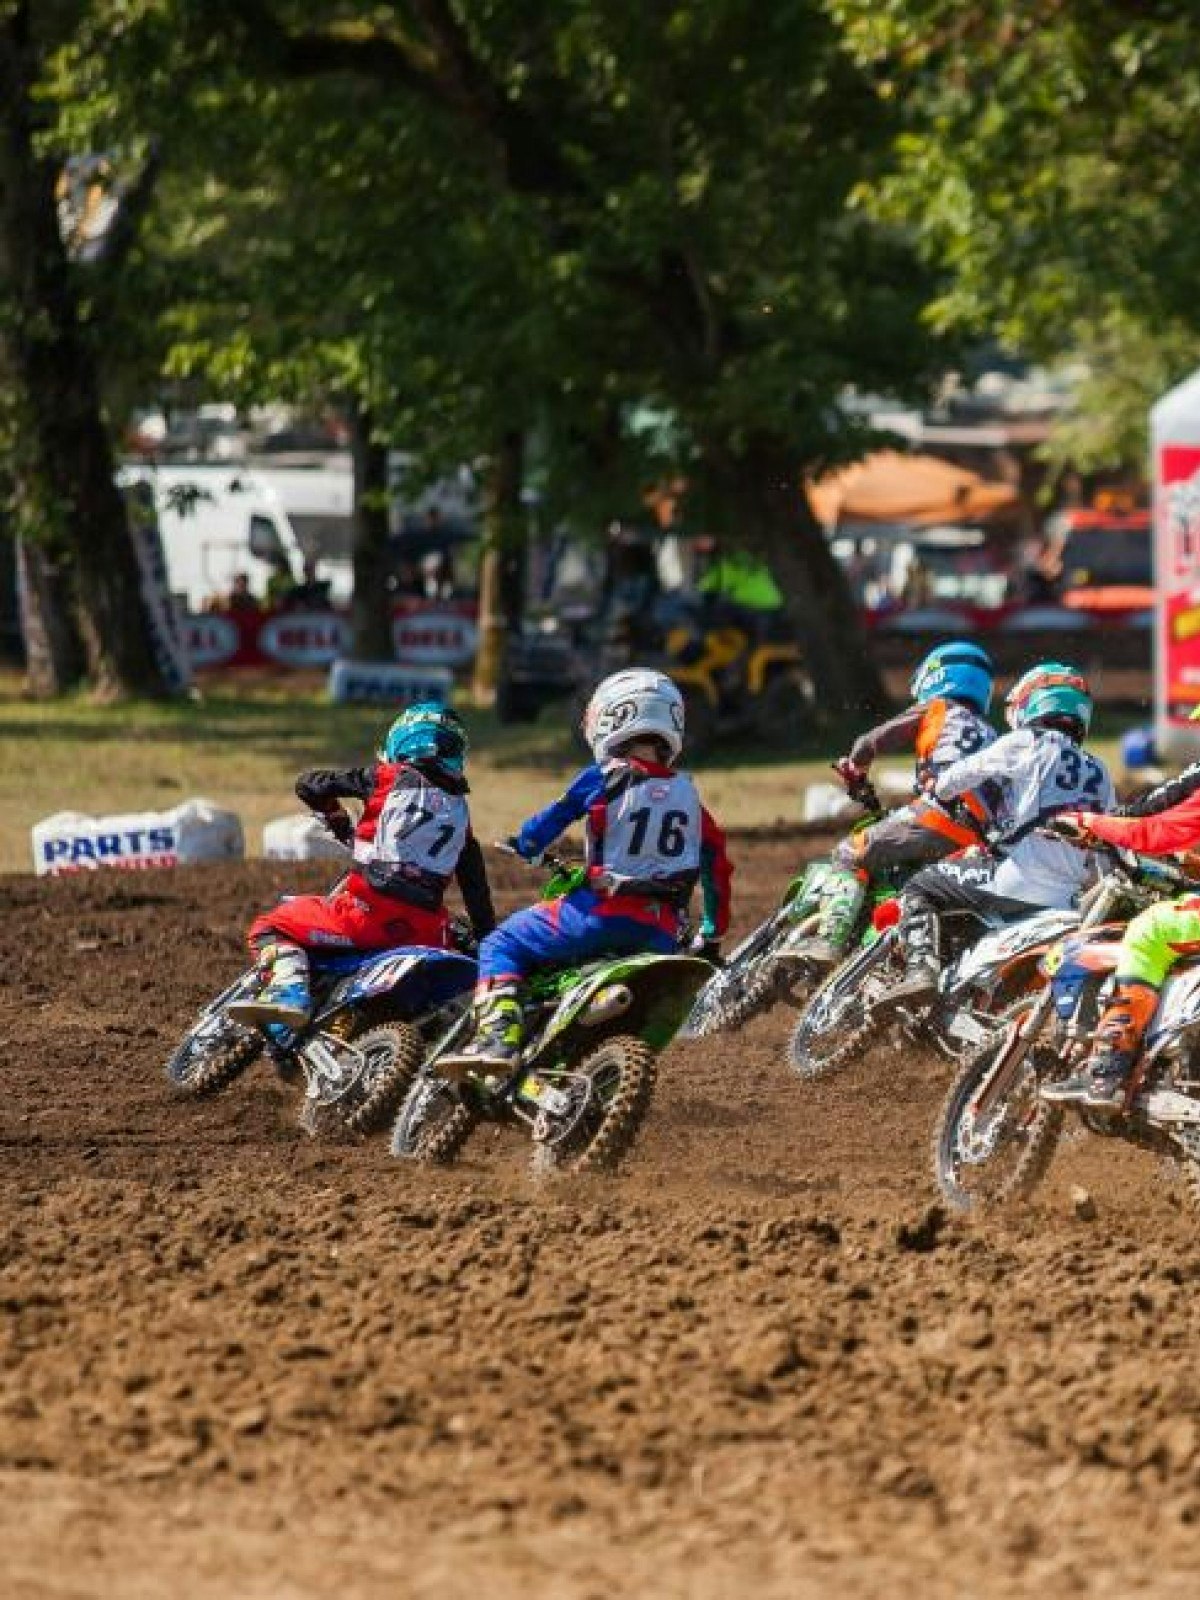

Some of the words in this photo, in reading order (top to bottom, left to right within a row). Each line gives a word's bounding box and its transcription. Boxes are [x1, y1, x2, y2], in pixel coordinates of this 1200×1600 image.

[1056, 749, 1103, 794] 32
[43, 827, 176, 862] PARTS
[627, 806, 688, 856] 16
